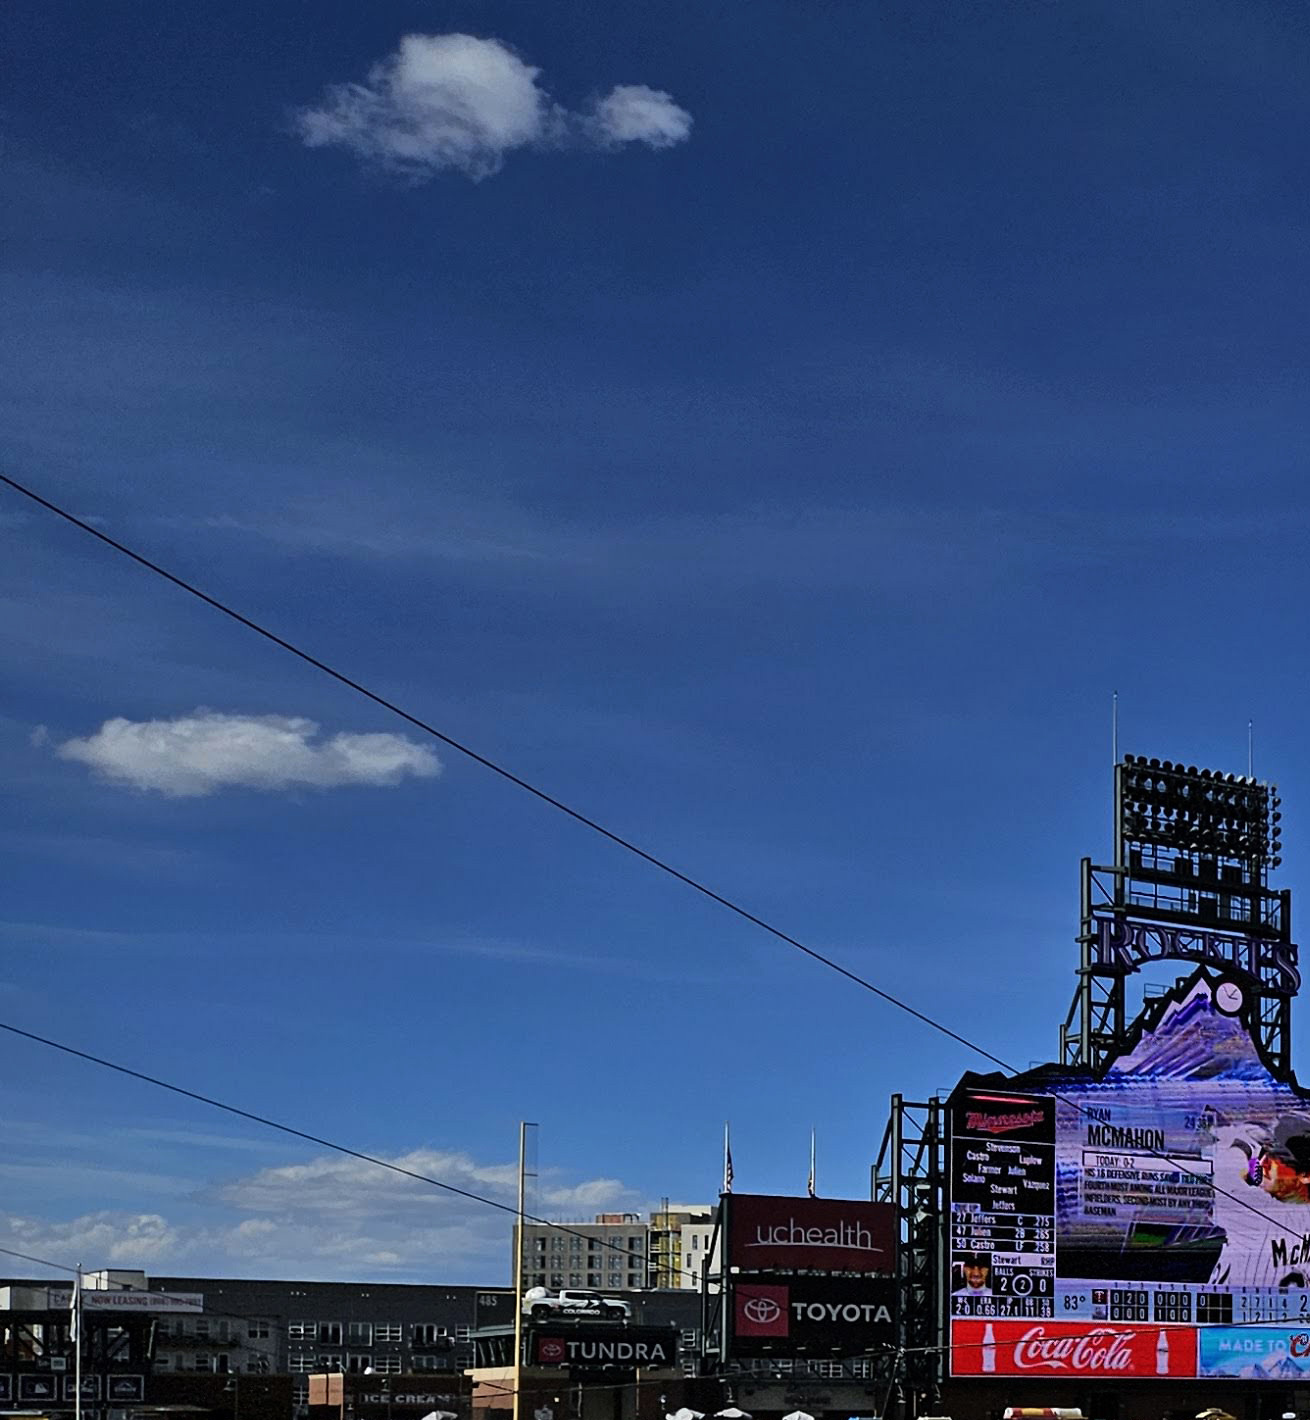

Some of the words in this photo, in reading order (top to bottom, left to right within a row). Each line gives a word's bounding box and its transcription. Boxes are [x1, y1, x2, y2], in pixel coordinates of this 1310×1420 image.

[1096, 914, 1301, 996] ROCKIES
[966, 1110, 1045, 1130] Minnesota
[1087, 1107, 1112, 1122] RYAN
[1088, 1125, 1165, 1151] MCMAHON
[967, 1150, 990, 1162] Castro
[1096, 1155, 1119, 1167] TODAY
[978, 1163, 1002, 1175] Farmer
[990, 1183, 1018, 1195] Stewart
[970, 1213, 996, 1225] Jeffers
[757, 1217, 872, 1250] uchealth
[970, 1240, 995, 1250] Castro
[993, 1254, 1022, 1265] Stewart
[1000, 1277, 1008, 1292] 2
[1038, 1279, 1046, 1293] 0
[92, 1296, 111, 1305] NOW
[112, 1297, 148, 1307] LEASING
[791, 1302, 893, 1324] TOYOTA
[567, 1341, 667, 1361] TUNDRA
[1014, 1326, 1134, 1369] Coca-Cola
[1218, 1339, 1253, 1352] MADE
[365, 1394, 390, 1404] ICE
[395, 1394, 450, 1404] CREAM
